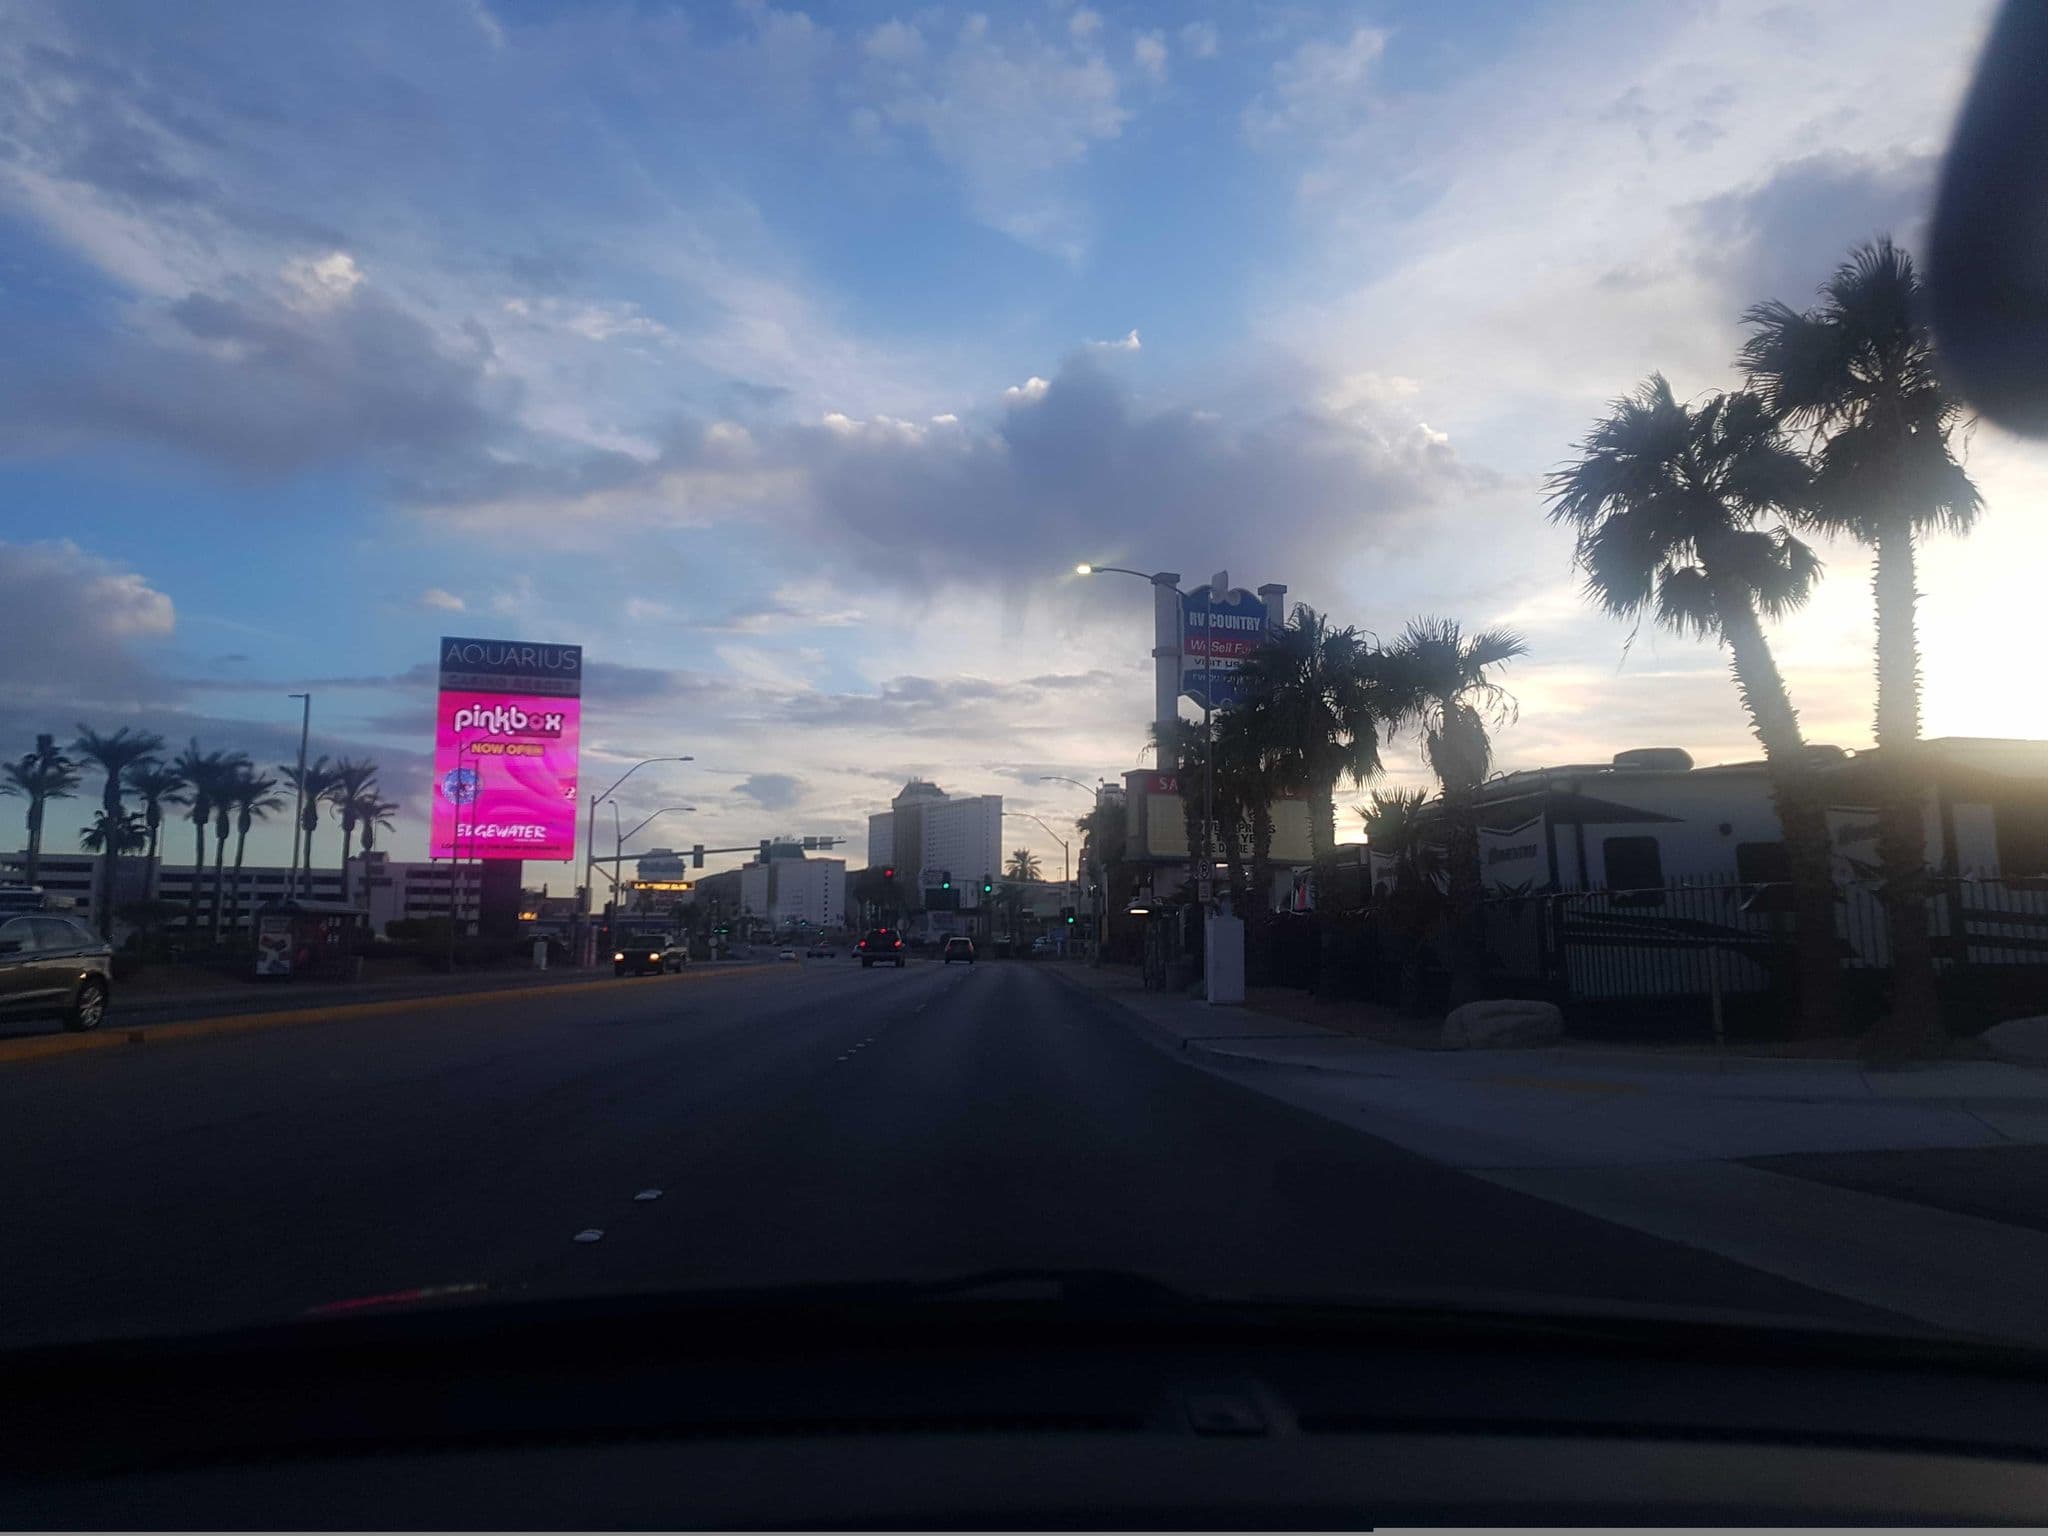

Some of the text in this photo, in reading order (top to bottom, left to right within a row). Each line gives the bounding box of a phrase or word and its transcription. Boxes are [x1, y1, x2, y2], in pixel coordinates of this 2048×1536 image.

[1189, 611, 1261, 631] RV COUNTRY
[445, 643, 577, 670] AQUARIUS
[1211, 640, 1231, 653] Sell
[454, 704, 563, 735] pinkbox
[471, 742, 504, 755] NOW
